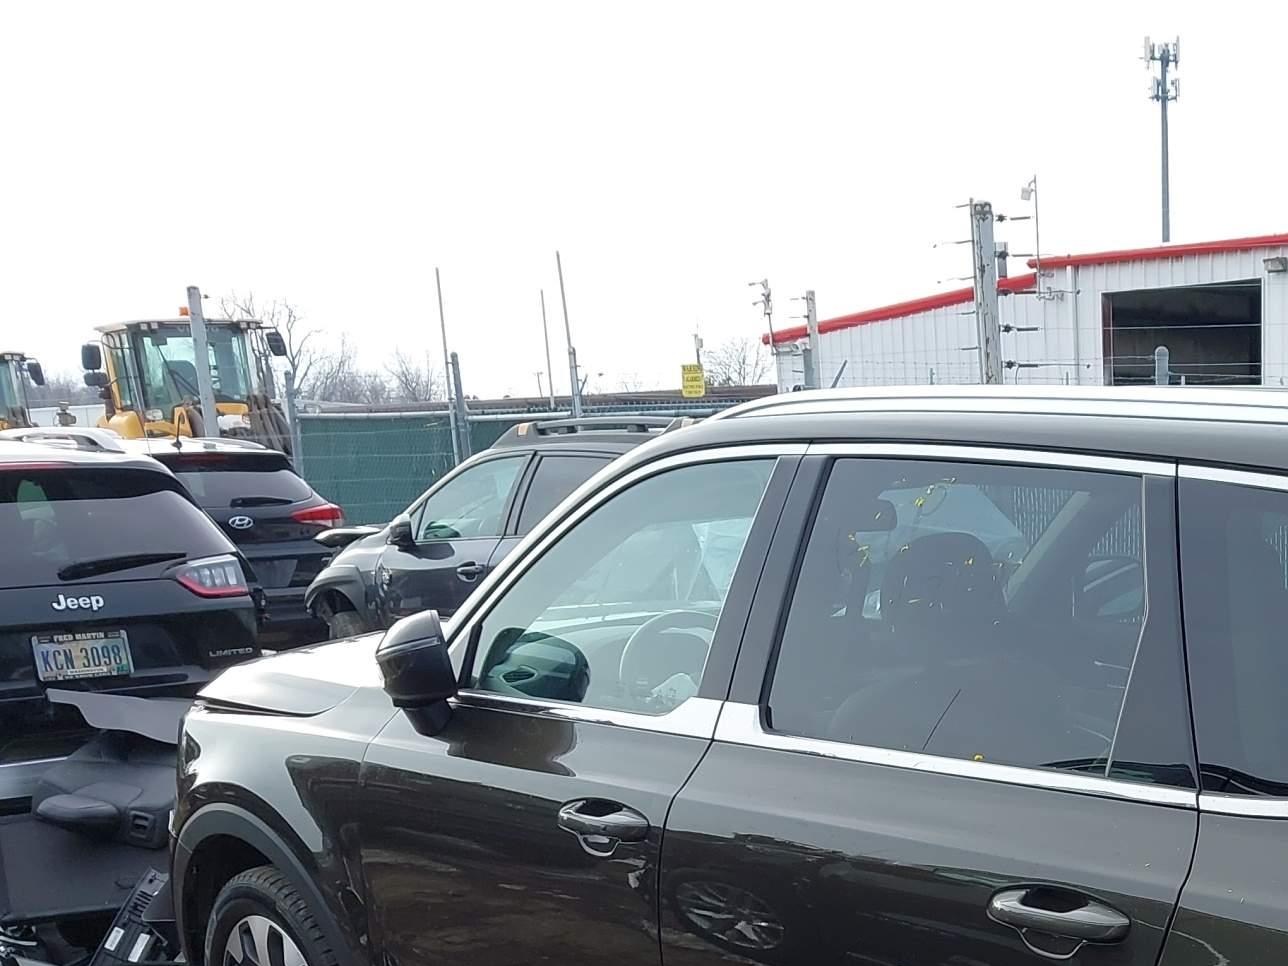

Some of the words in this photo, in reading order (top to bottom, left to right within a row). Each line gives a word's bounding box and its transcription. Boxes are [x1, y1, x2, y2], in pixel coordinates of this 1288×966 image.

[51, 593, 105, 611] Jeep
[53, 634, 74, 643] FRED
[74, 631, 105, 641] MARTIN
[40, 648, 75, 673] KCN
[79, 644, 123, 668] 3098
[208, 647, 253, 657] LIMITED
